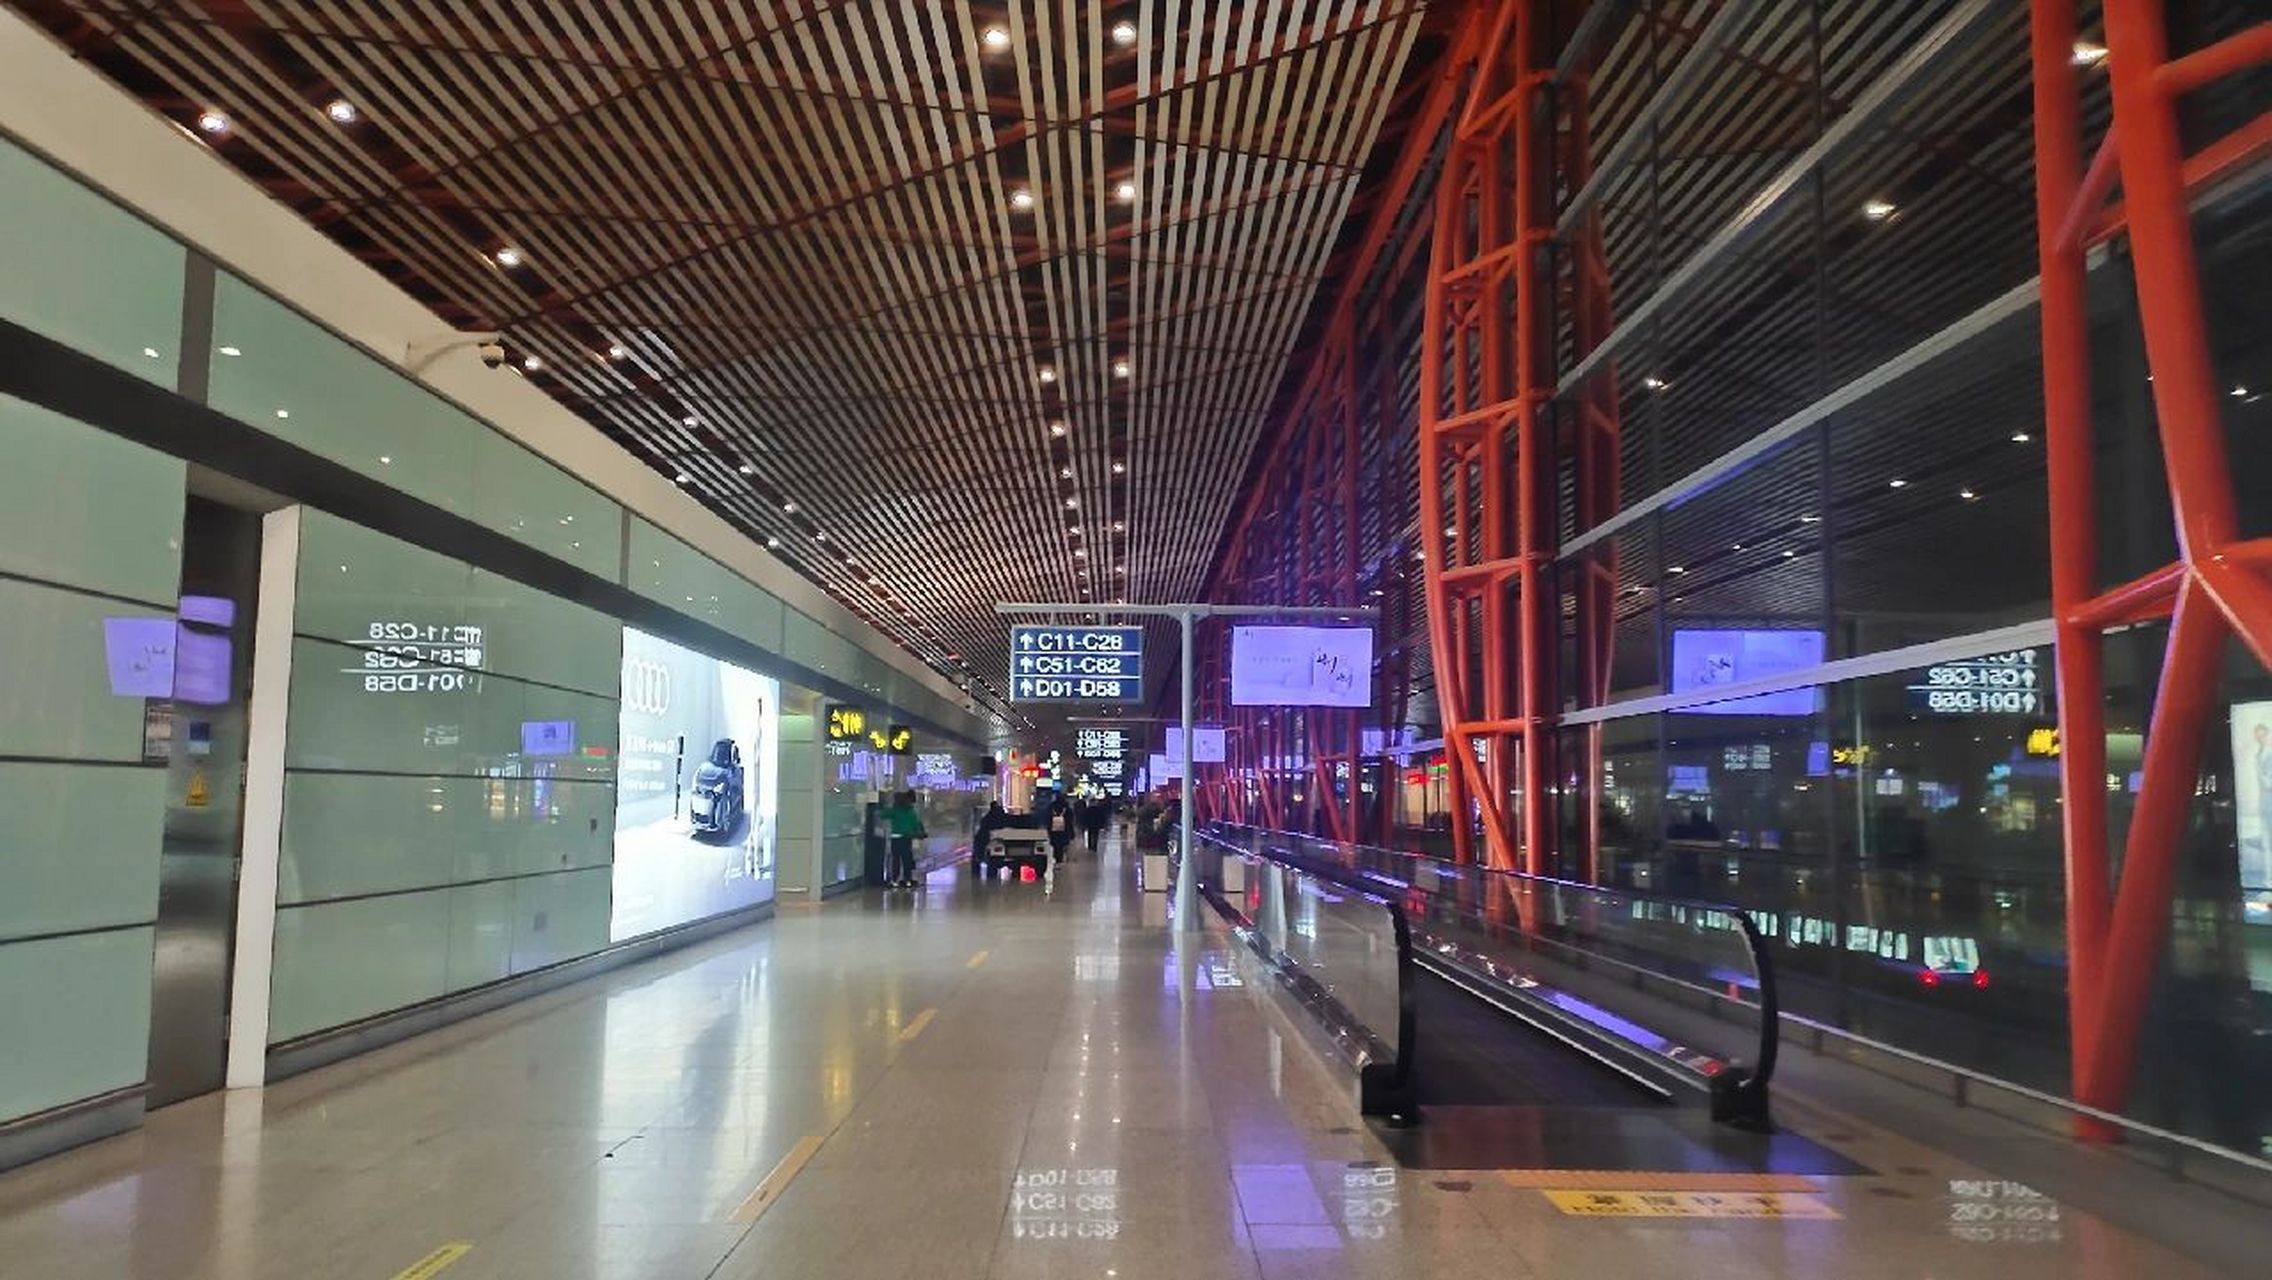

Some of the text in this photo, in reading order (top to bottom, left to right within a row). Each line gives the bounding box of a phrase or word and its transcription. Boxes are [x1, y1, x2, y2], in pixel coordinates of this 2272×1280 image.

[1038, 633, 1122, 650] C11-C28
[1036, 657, 1121, 673] C51-C62
[1036, 680, 1121, 697] D01-D58
